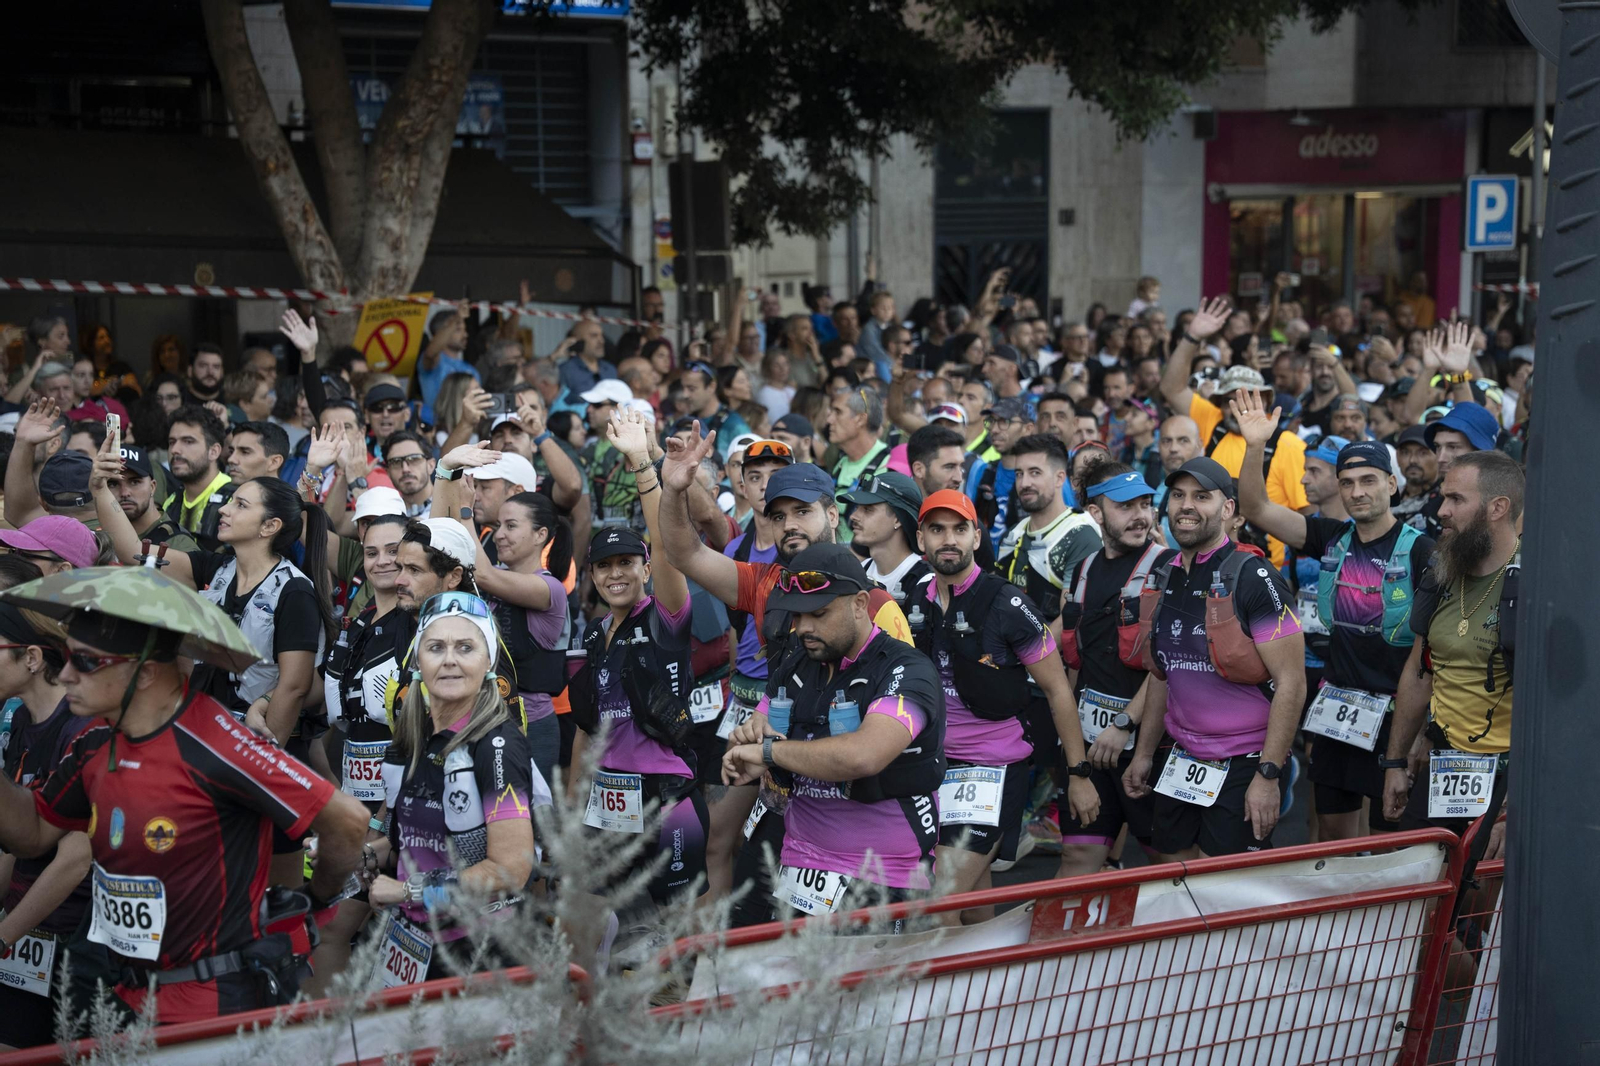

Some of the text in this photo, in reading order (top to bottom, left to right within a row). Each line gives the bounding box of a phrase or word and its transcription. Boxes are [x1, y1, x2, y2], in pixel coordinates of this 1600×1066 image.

[1299, 124, 1379, 159] adesso
[1476, 183, 1508, 243] P
[1264, 577, 1283, 611] Espabrok
[1020, 603, 1043, 632] Espabrok
[1336, 704, 1359, 726] 84
[495, 749, 505, 790] Espabrok
[1185, 763, 1208, 785] 90
[600, 789, 627, 813] 165
[954, 783, 977, 802] 48
[1442, 775, 1483, 796] 2756
[673, 828, 682, 861] Espabrok
[796, 867, 829, 893] 106
[101, 893, 153, 930] 3386
[385, 945, 418, 986] 2030
